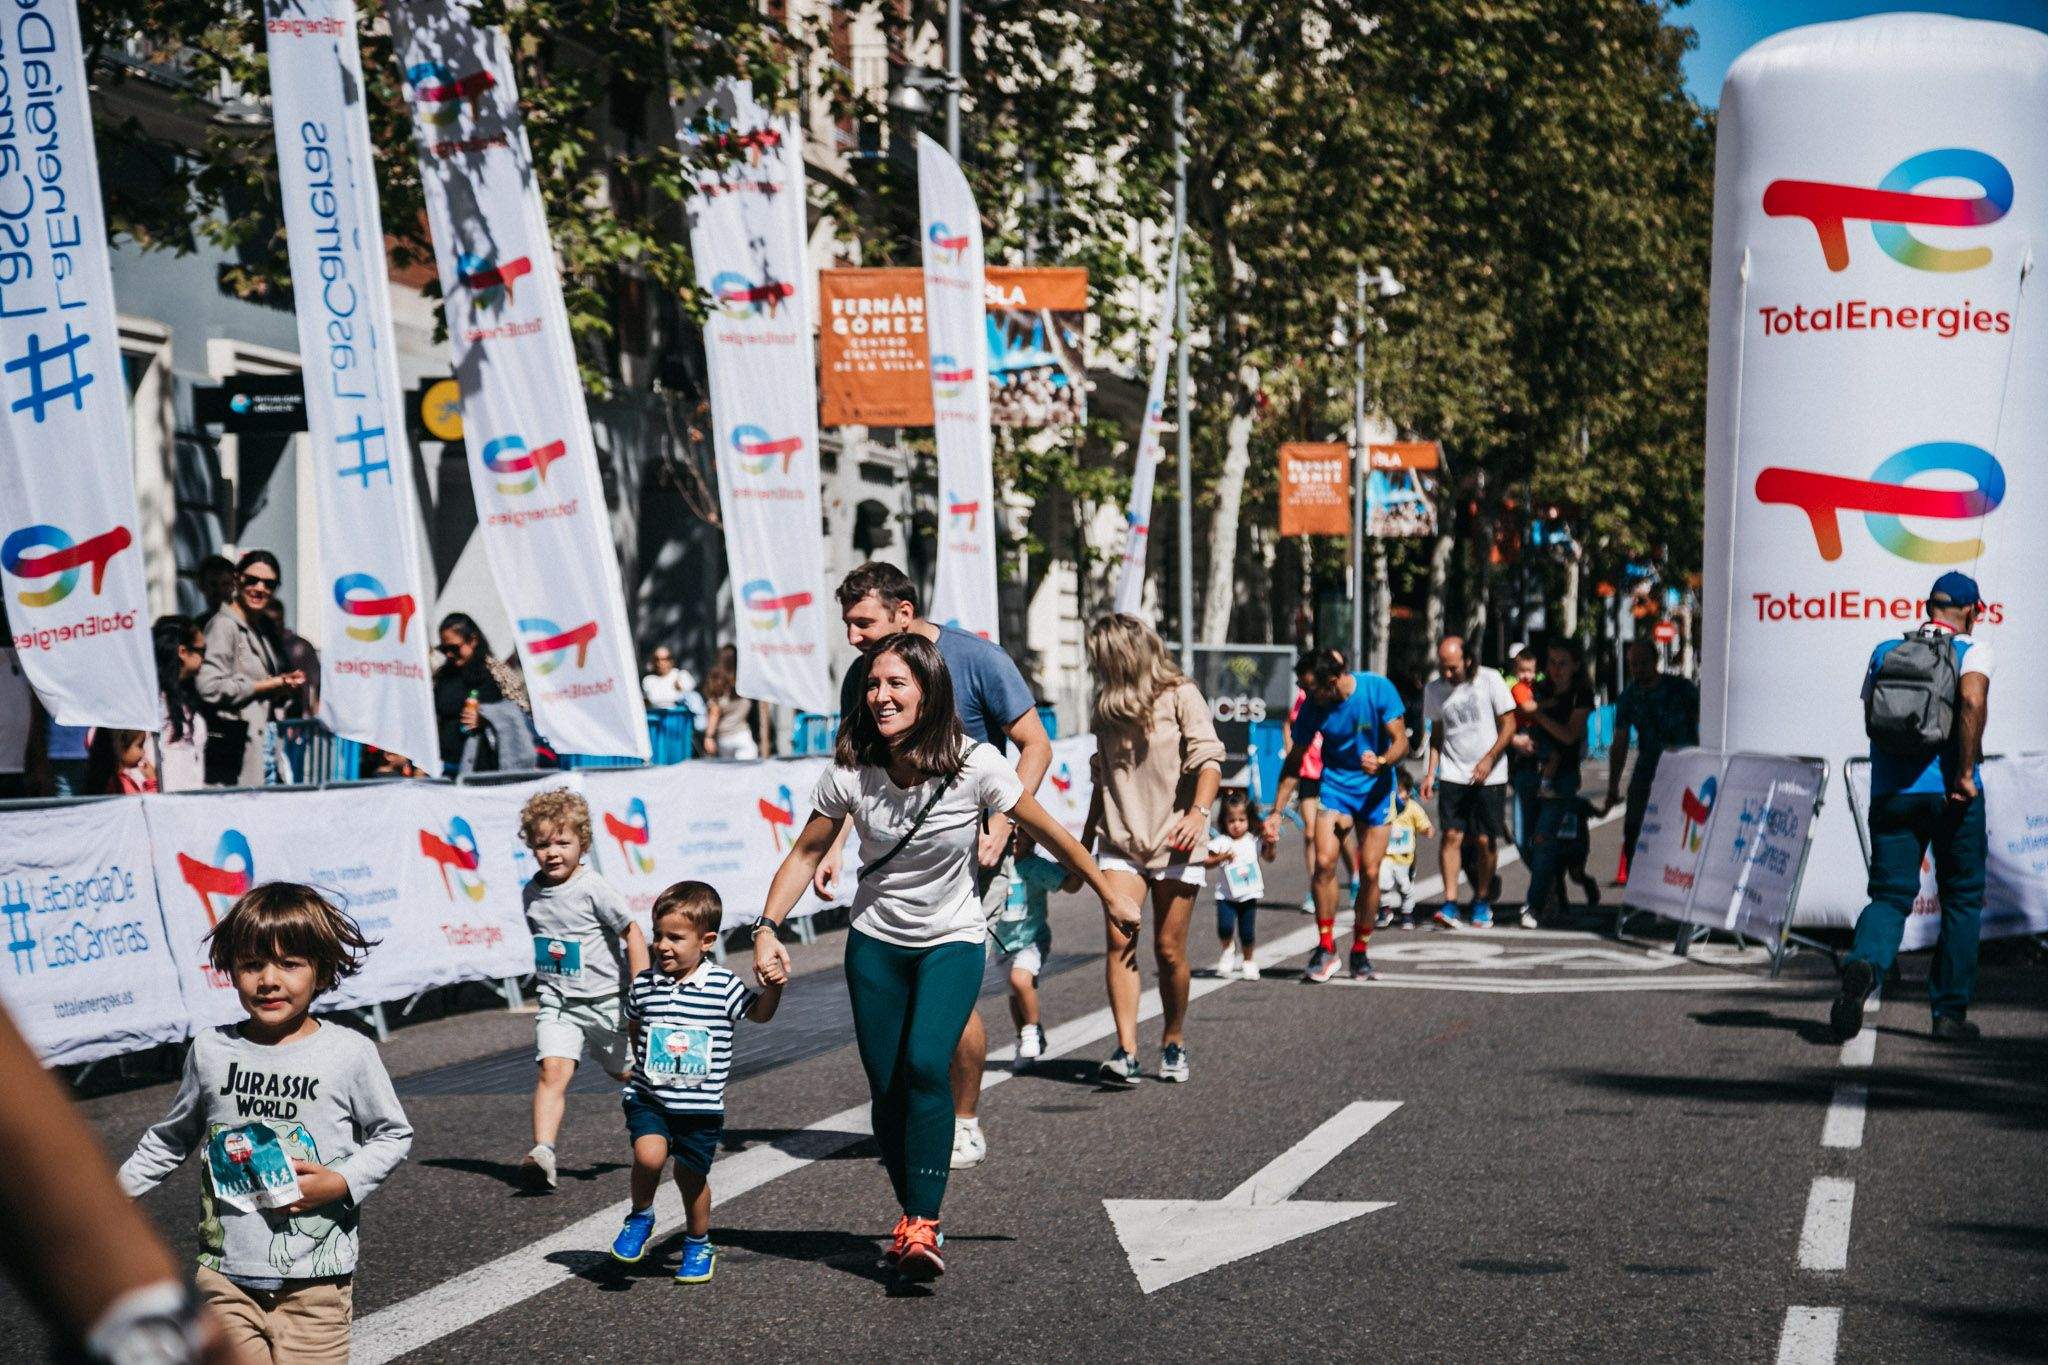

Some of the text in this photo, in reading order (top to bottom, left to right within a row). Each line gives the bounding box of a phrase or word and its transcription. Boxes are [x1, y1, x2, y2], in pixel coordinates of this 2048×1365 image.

[832, 293, 924, 315] FERNÁN
[1759, 300, 2012, 338] TotalEnergies
[832, 314, 924, 335] GÓMEZ
[40, 921, 148, 968] LasCarreras
[219, 1062, 320, 1101] JURASSIC
[235, 1094, 298, 1119] WORLD
